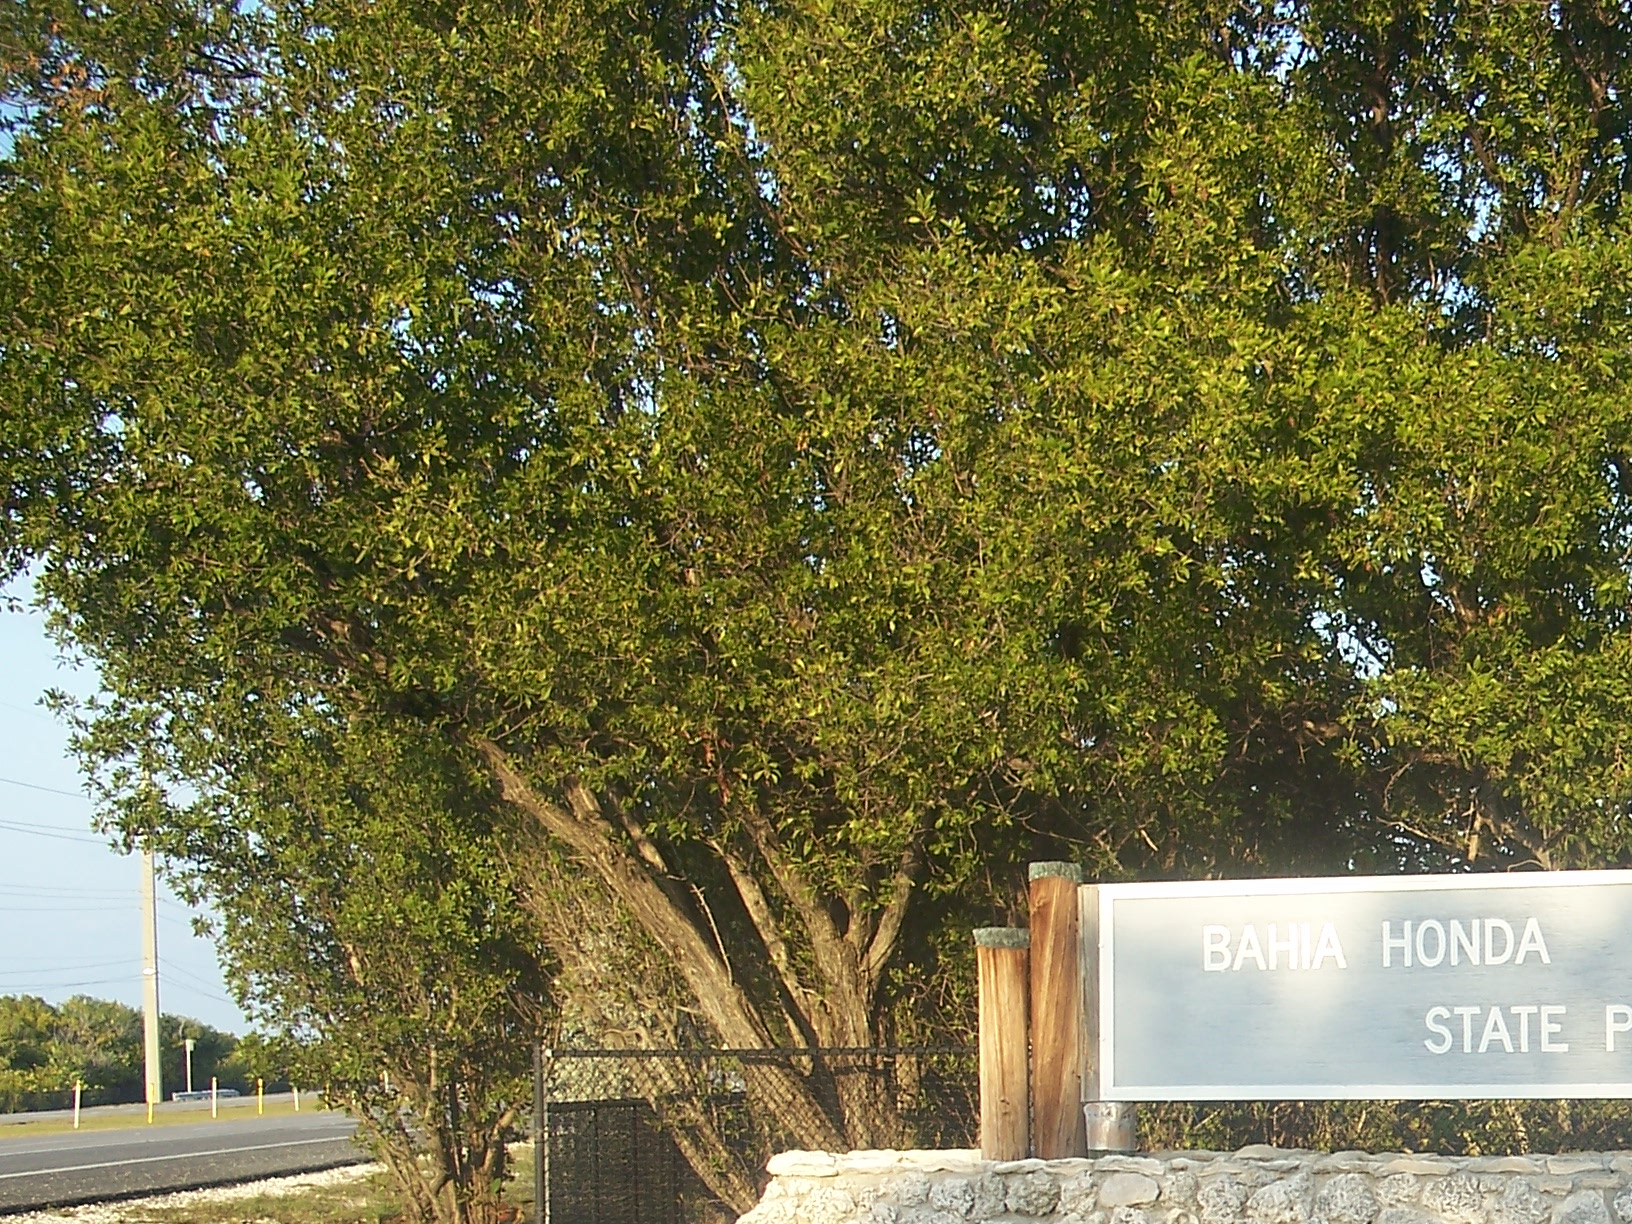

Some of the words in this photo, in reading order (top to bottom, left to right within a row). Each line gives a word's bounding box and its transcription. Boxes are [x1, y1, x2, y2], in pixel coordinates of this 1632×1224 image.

[1203, 923, 1347, 973] BAHIA
[1382, 917, 1551, 968] HONDA
[1423, 1005, 1569, 1055] STATE
